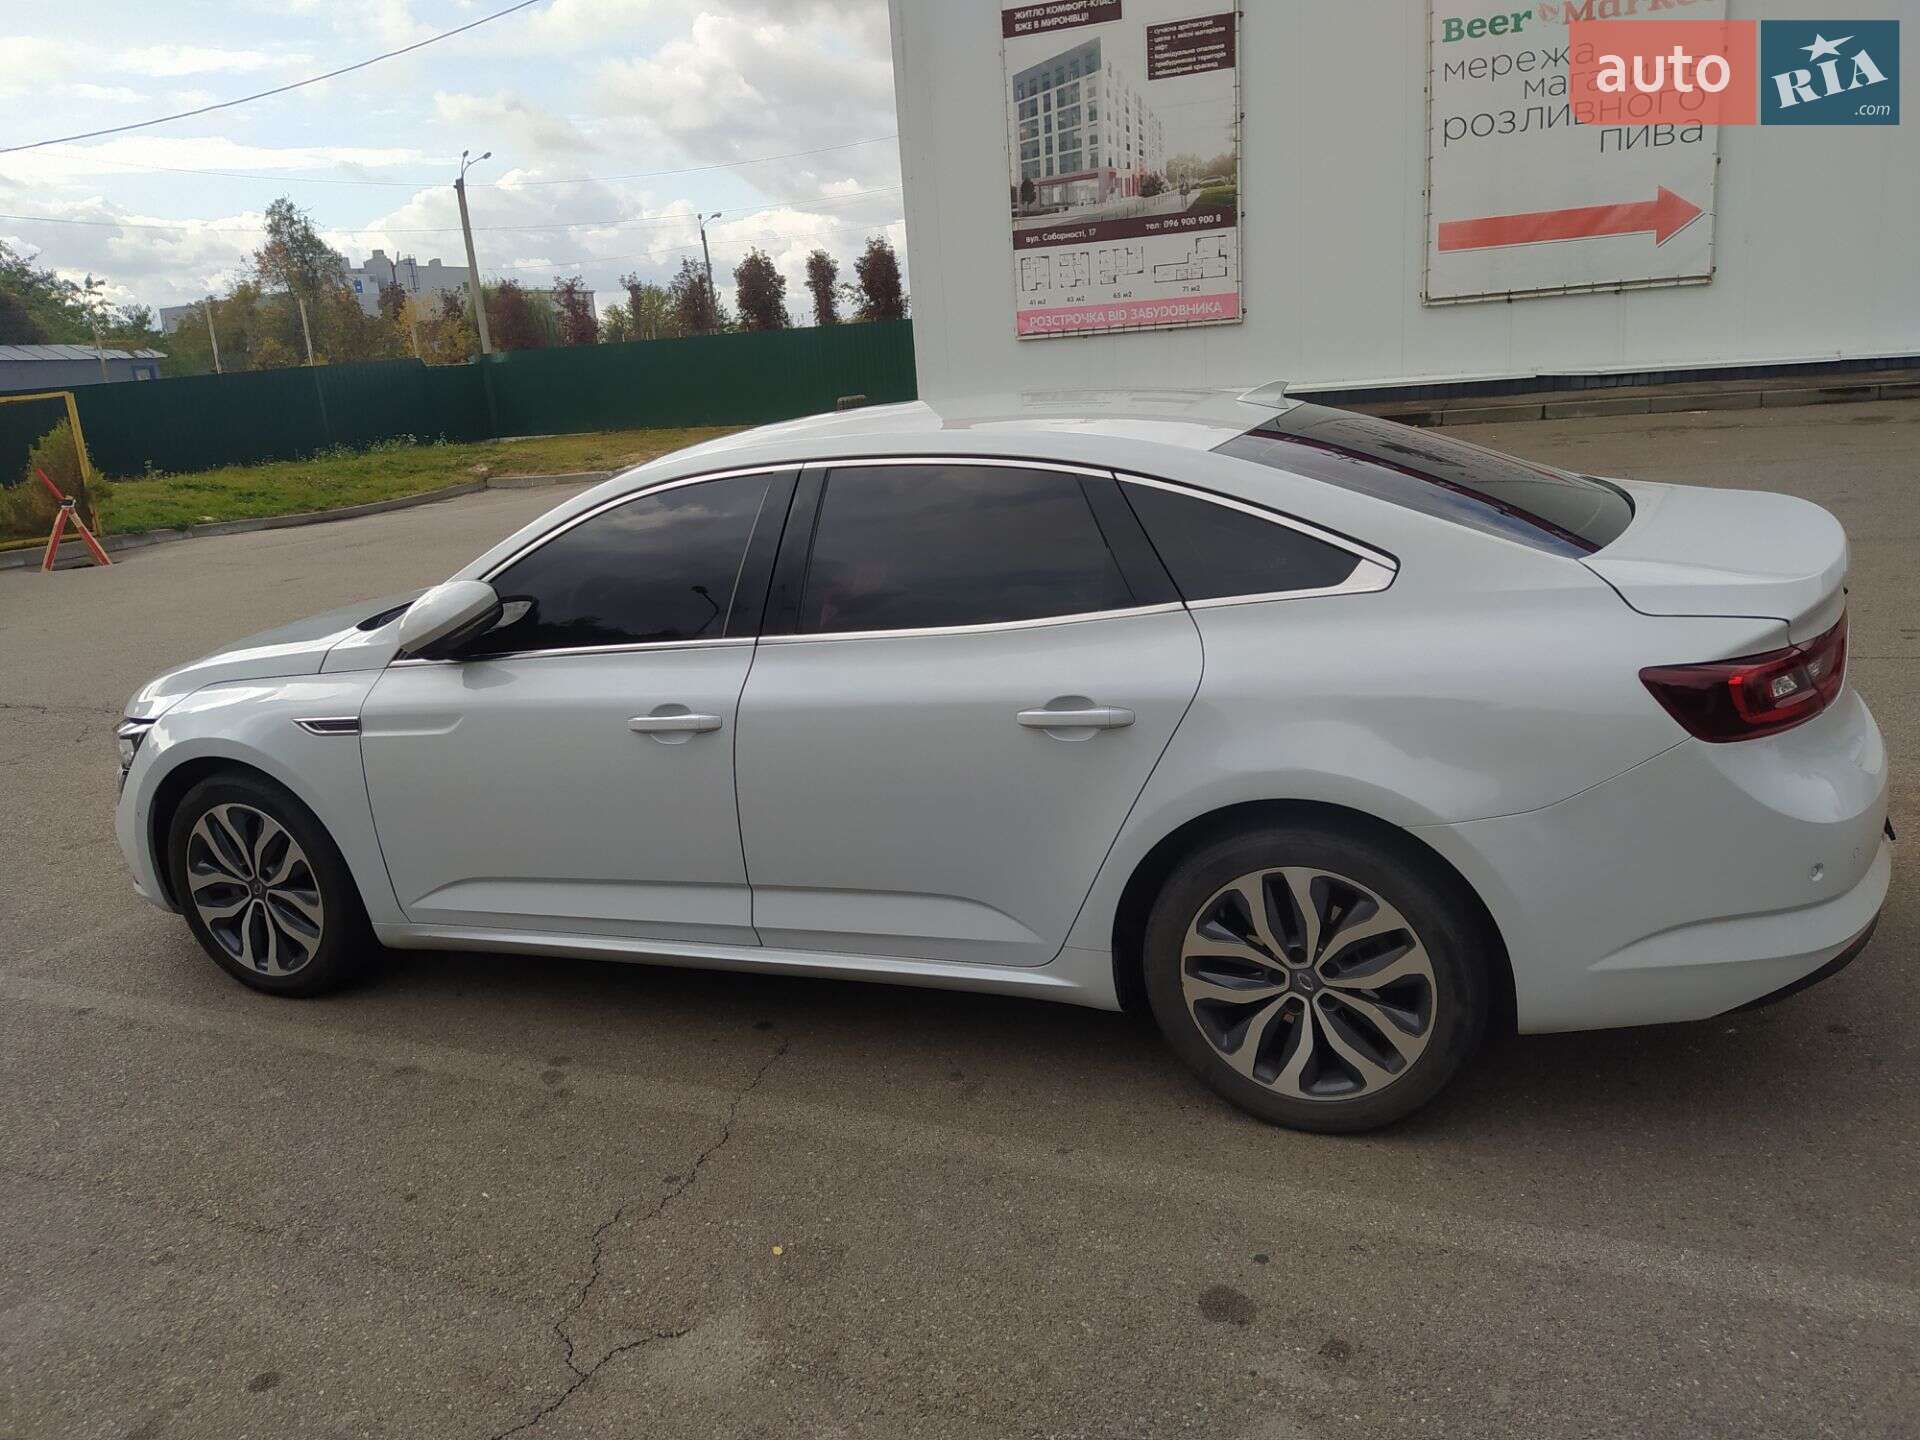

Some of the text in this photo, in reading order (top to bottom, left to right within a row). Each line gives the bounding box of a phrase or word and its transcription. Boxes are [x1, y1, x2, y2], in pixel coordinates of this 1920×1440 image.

[1014, 8, 1045, 20] ЖИТЛО
[1015, 21, 1033, 32] ВЖЕ
[1033, 20, 1040, 29] В
[1441, 8, 1533, 43] Beer
[1443, 42, 1597, 83] мережа
[1443, 89, 1706, 147] розливного
[1600, 117, 1705, 153] пива
[1163, 218, 1179, 228] 096
[1181, 217, 1197, 227] 900
[1198, 215, 1214, 225] 900
[1215, 214, 1222, 223] 8
[1025, 228, 1097, 244] вул. Соборності, 17
[1030, 301, 1222, 327] РОЗСТРОЧКА ВІД ЗАБУДОВНИКА
